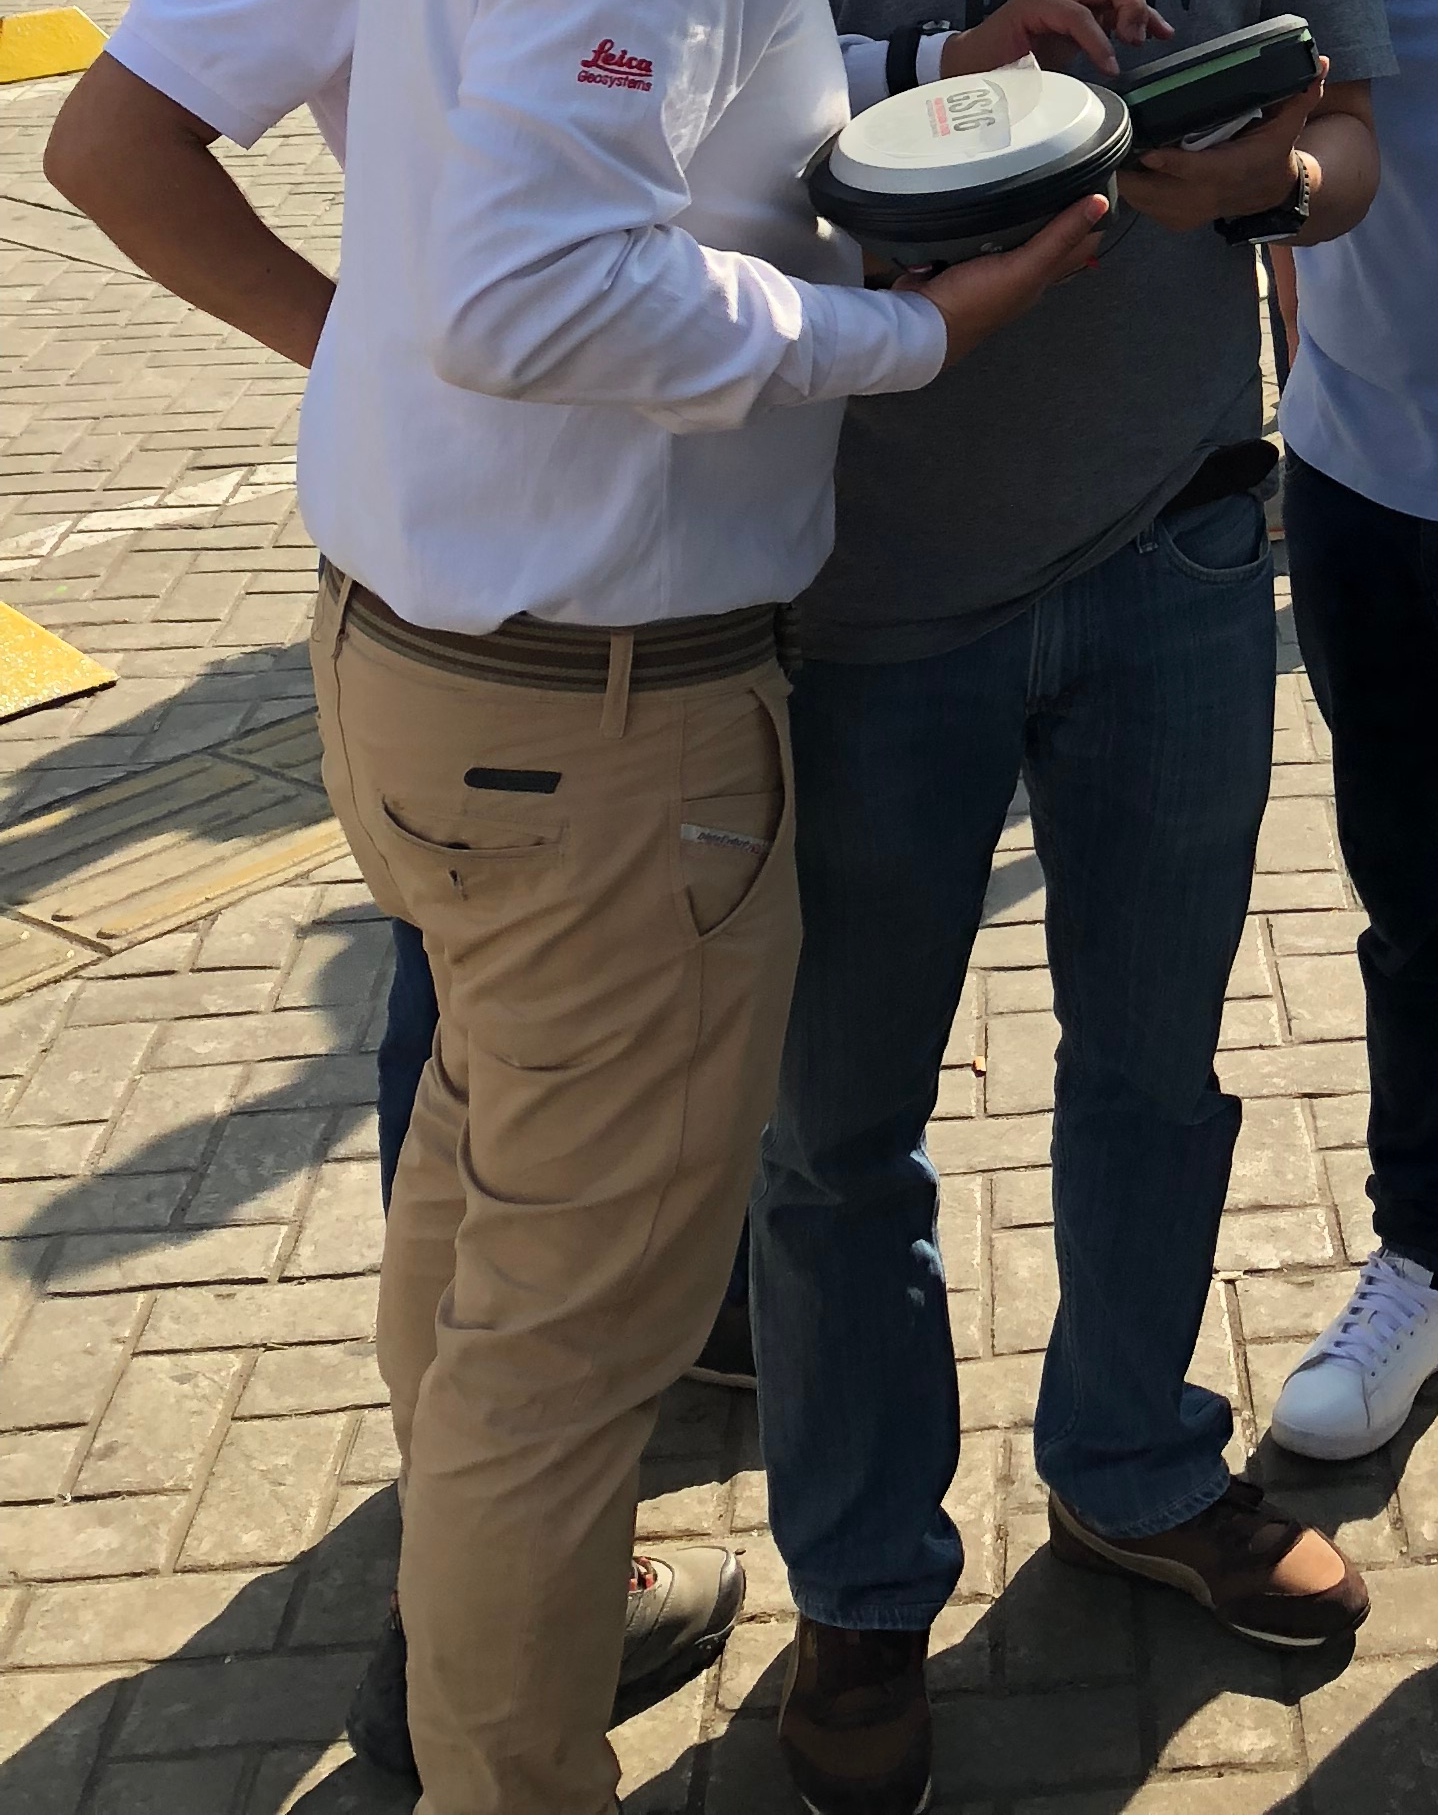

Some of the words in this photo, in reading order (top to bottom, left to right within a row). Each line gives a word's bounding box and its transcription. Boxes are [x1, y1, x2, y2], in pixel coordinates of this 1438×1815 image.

[580, 38, 653, 77] Leica
[578, 70, 653, 92] Geosystems
[947, 88, 996, 131] GS16
